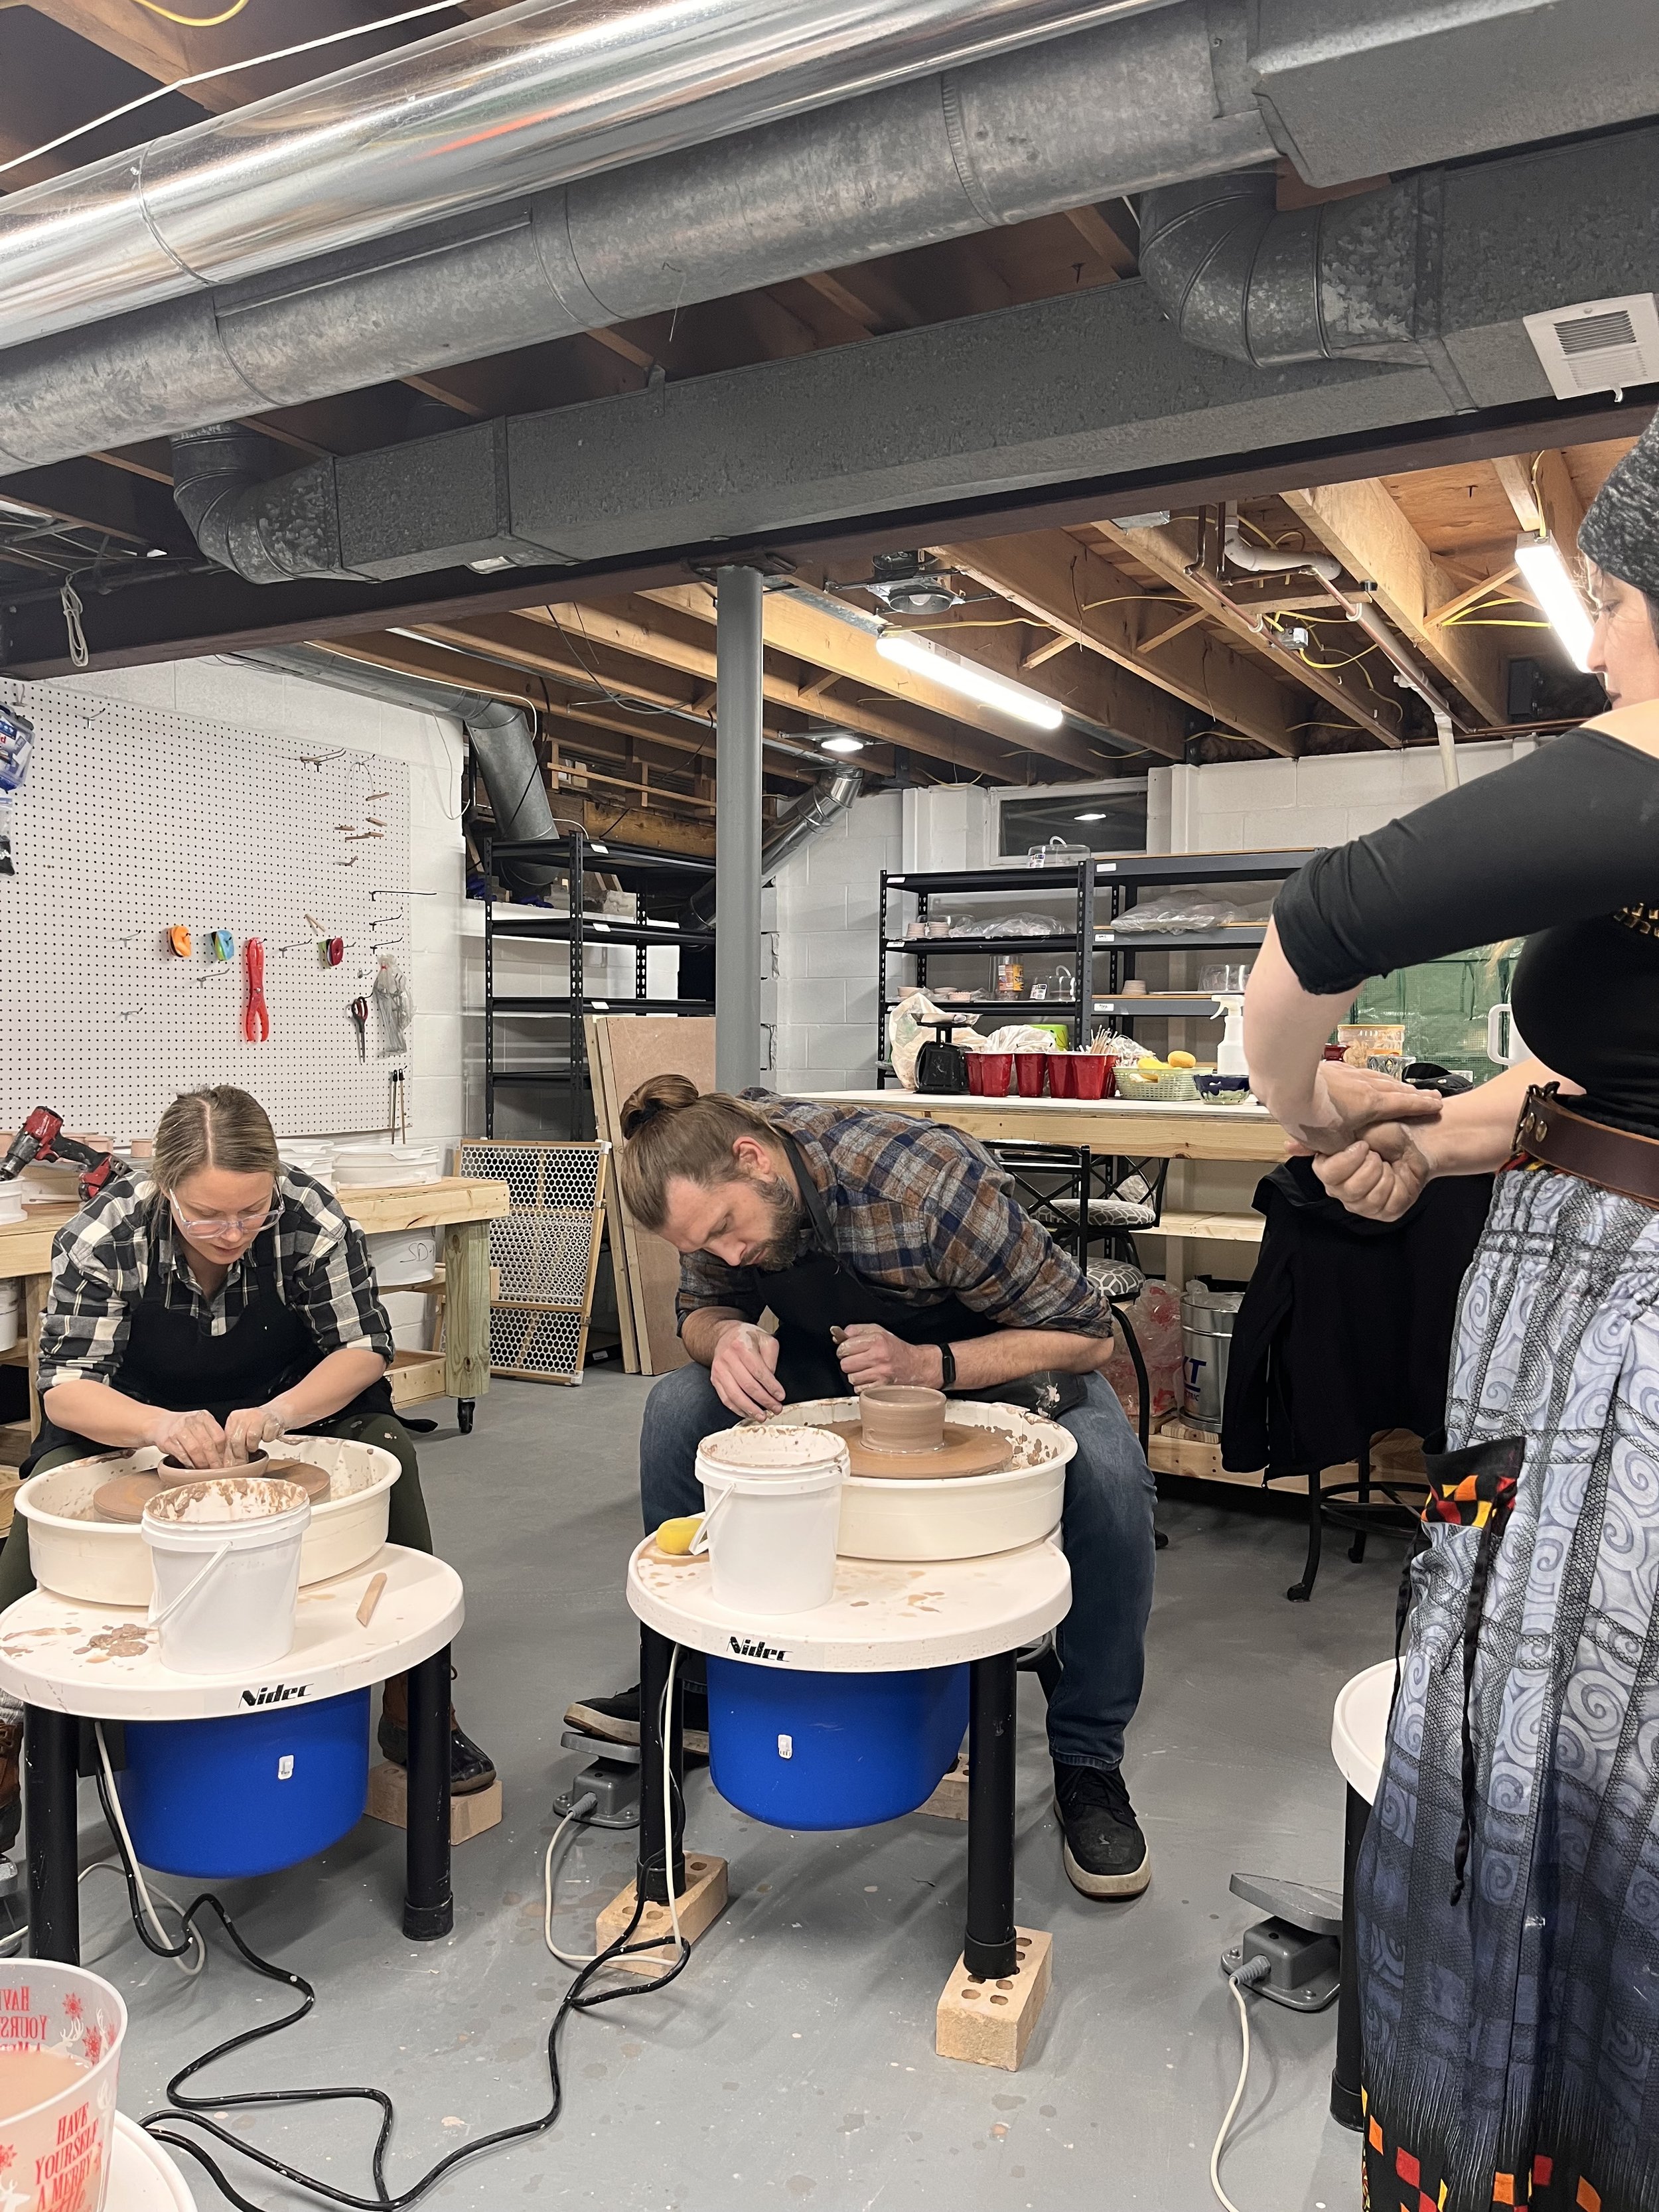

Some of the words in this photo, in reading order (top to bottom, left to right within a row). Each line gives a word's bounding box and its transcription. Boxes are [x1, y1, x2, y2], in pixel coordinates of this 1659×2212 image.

[727, 1637, 794, 1662] Nidec
[238, 1683, 315, 1708] Nidec
[56, 2101, 89, 2145] HAVE
[35, 2118, 99, 2185] YOURSELF
[36, 2185, 46, 2212] A
[52, 2150, 93, 2205] MERRY
